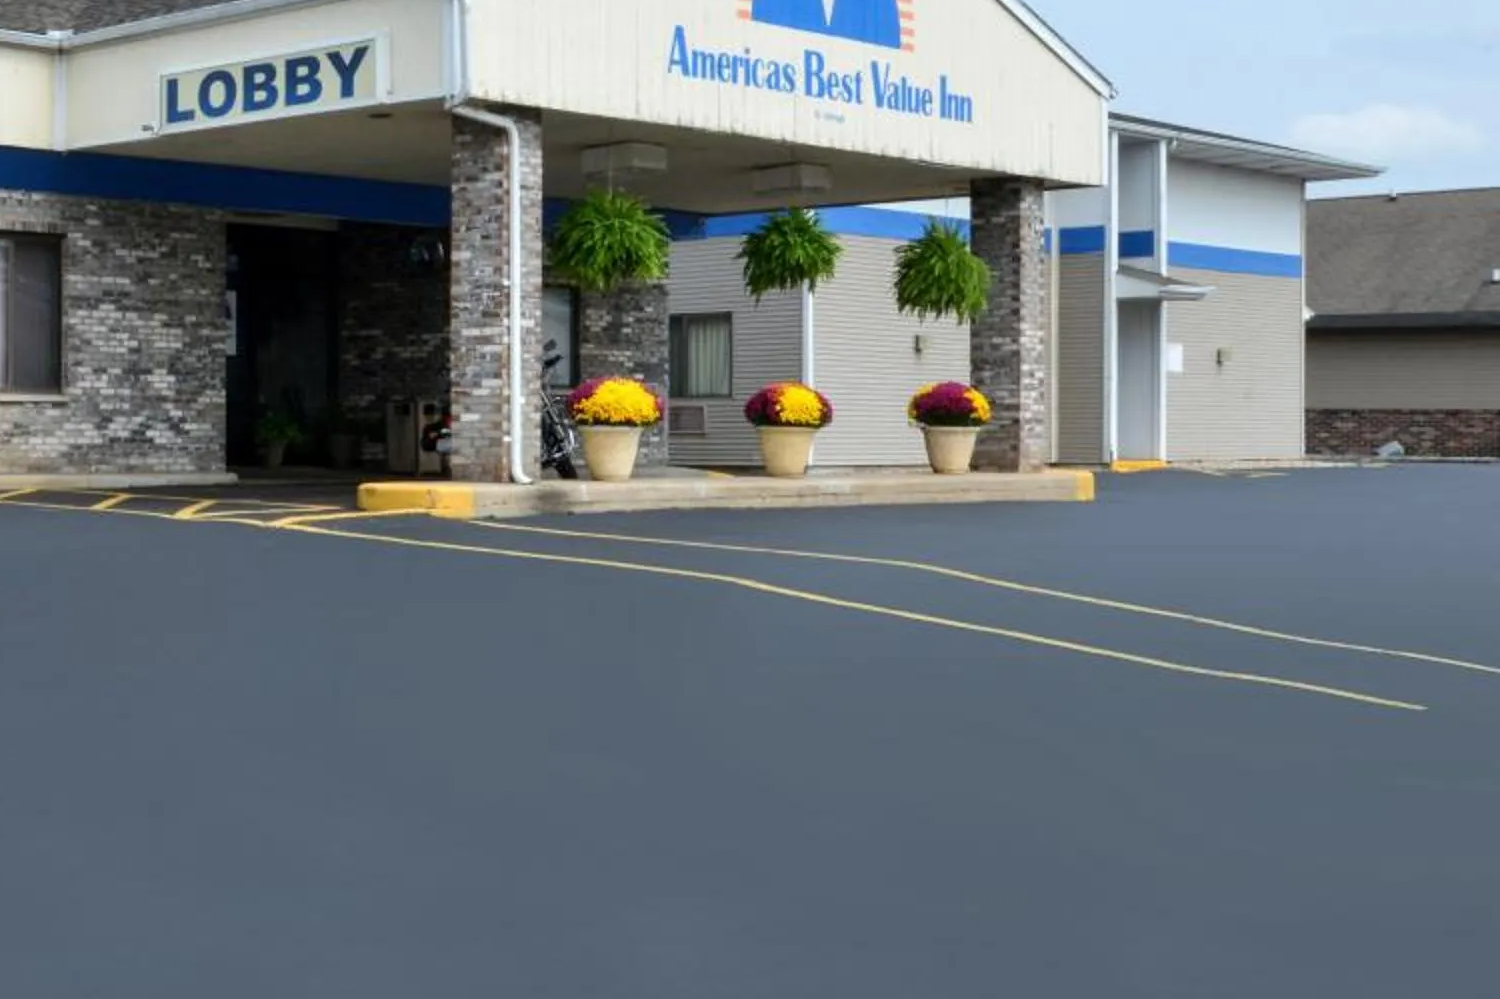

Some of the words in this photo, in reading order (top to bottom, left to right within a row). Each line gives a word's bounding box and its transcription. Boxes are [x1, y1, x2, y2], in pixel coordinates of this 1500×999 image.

[166, 45, 369, 124] LOBBY
[668, 24, 796, 92] Americas
[803, 50, 863, 104] Best
[871, 60, 933, 116] Value
[939, 75, 973, 123] Inn
